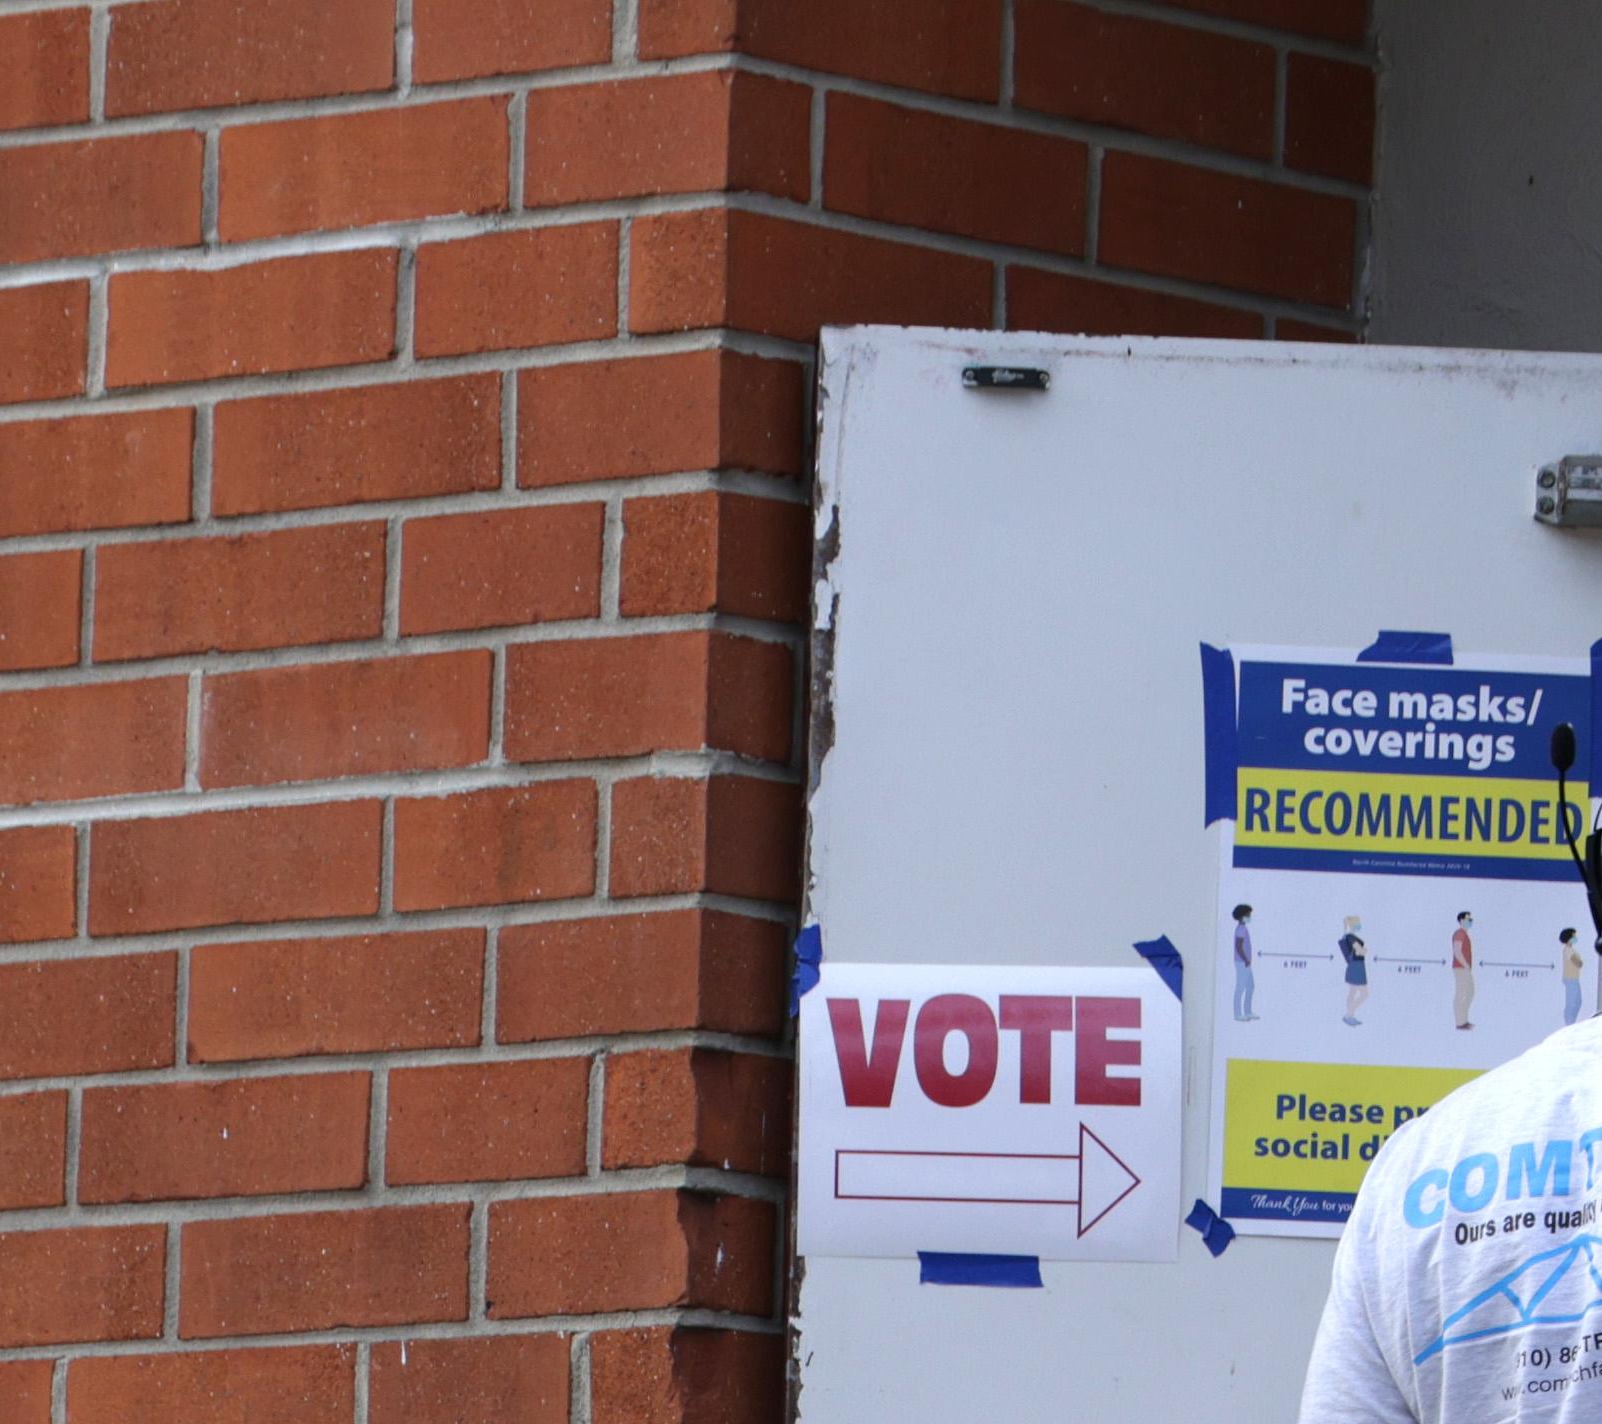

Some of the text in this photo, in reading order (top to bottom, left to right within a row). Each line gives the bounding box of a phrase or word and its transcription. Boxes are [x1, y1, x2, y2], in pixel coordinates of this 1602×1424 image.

[1281, 678, 1544, 727] Face masks/
[1303, 721, 1516, 772] coverings
[1244, 786, 1584, 846] RECOMMENDED
[1290, 961, 1307, 970] FEET
[1404, 966, 1421, 974] FEET
[1512, 970, 1529, 978] FEET
[826, 993, 1142, 1108] VOTE
[1276, 1094, 1385, 1124] Please
[1254, 1132, 1350, 1161] social
[1251, 1193, 1292, 1213] Thank
[1293, 1196, 1319, 1217] You
[1322, 1200, 1336, 1211] for
[1455, 1219, 1496, 1246] Ours
[1503, 1211, 1536, 1233] are
